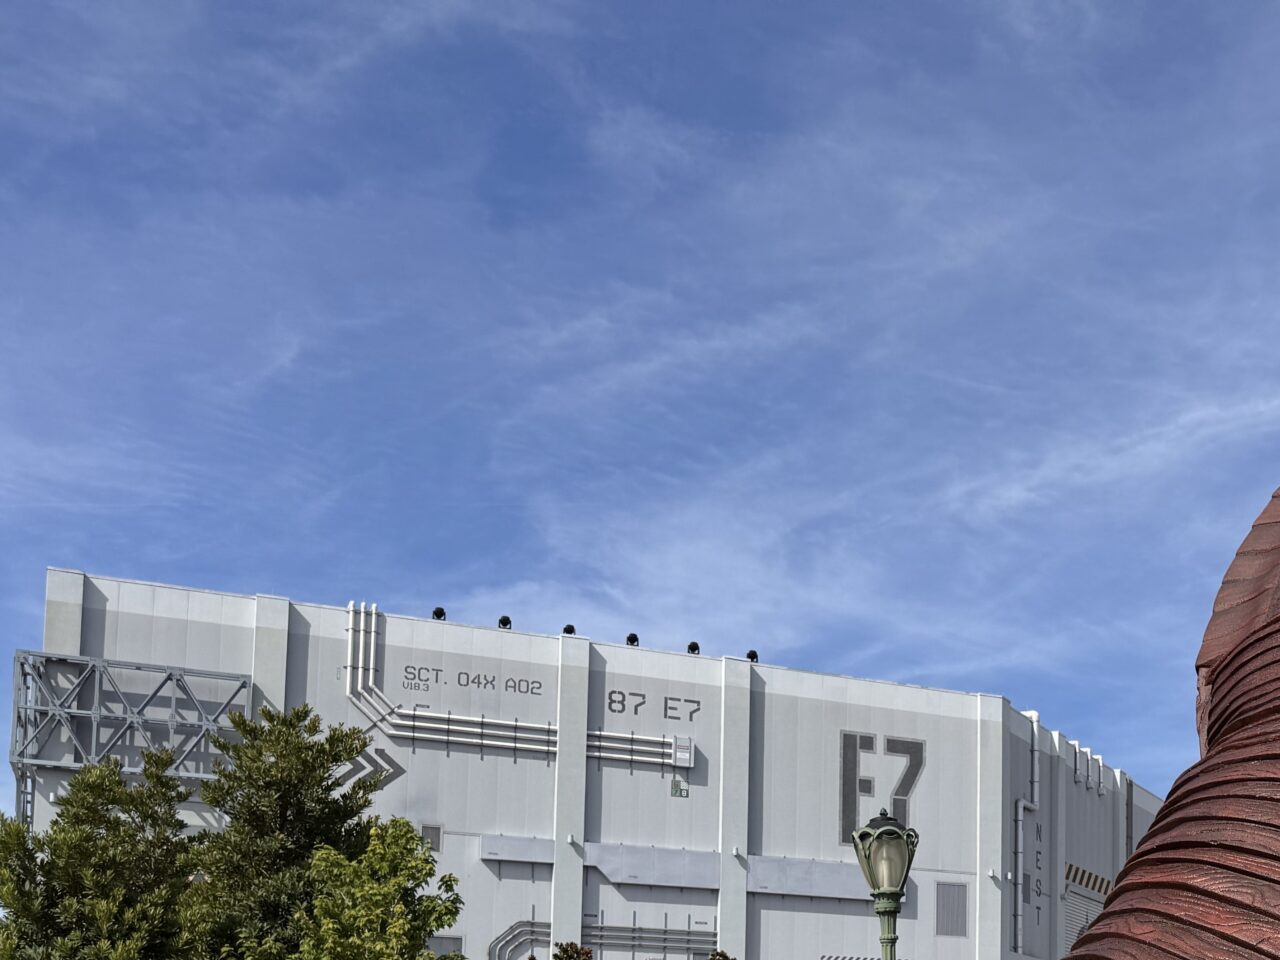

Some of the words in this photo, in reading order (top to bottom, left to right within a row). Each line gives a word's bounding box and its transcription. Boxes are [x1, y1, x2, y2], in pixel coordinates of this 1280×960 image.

[404, 665, 448, 685] SCT.
[457, 671, 496, 690] 04X
[608, 690, 646, 715] 87
[664, 696, 701, 722] E7
